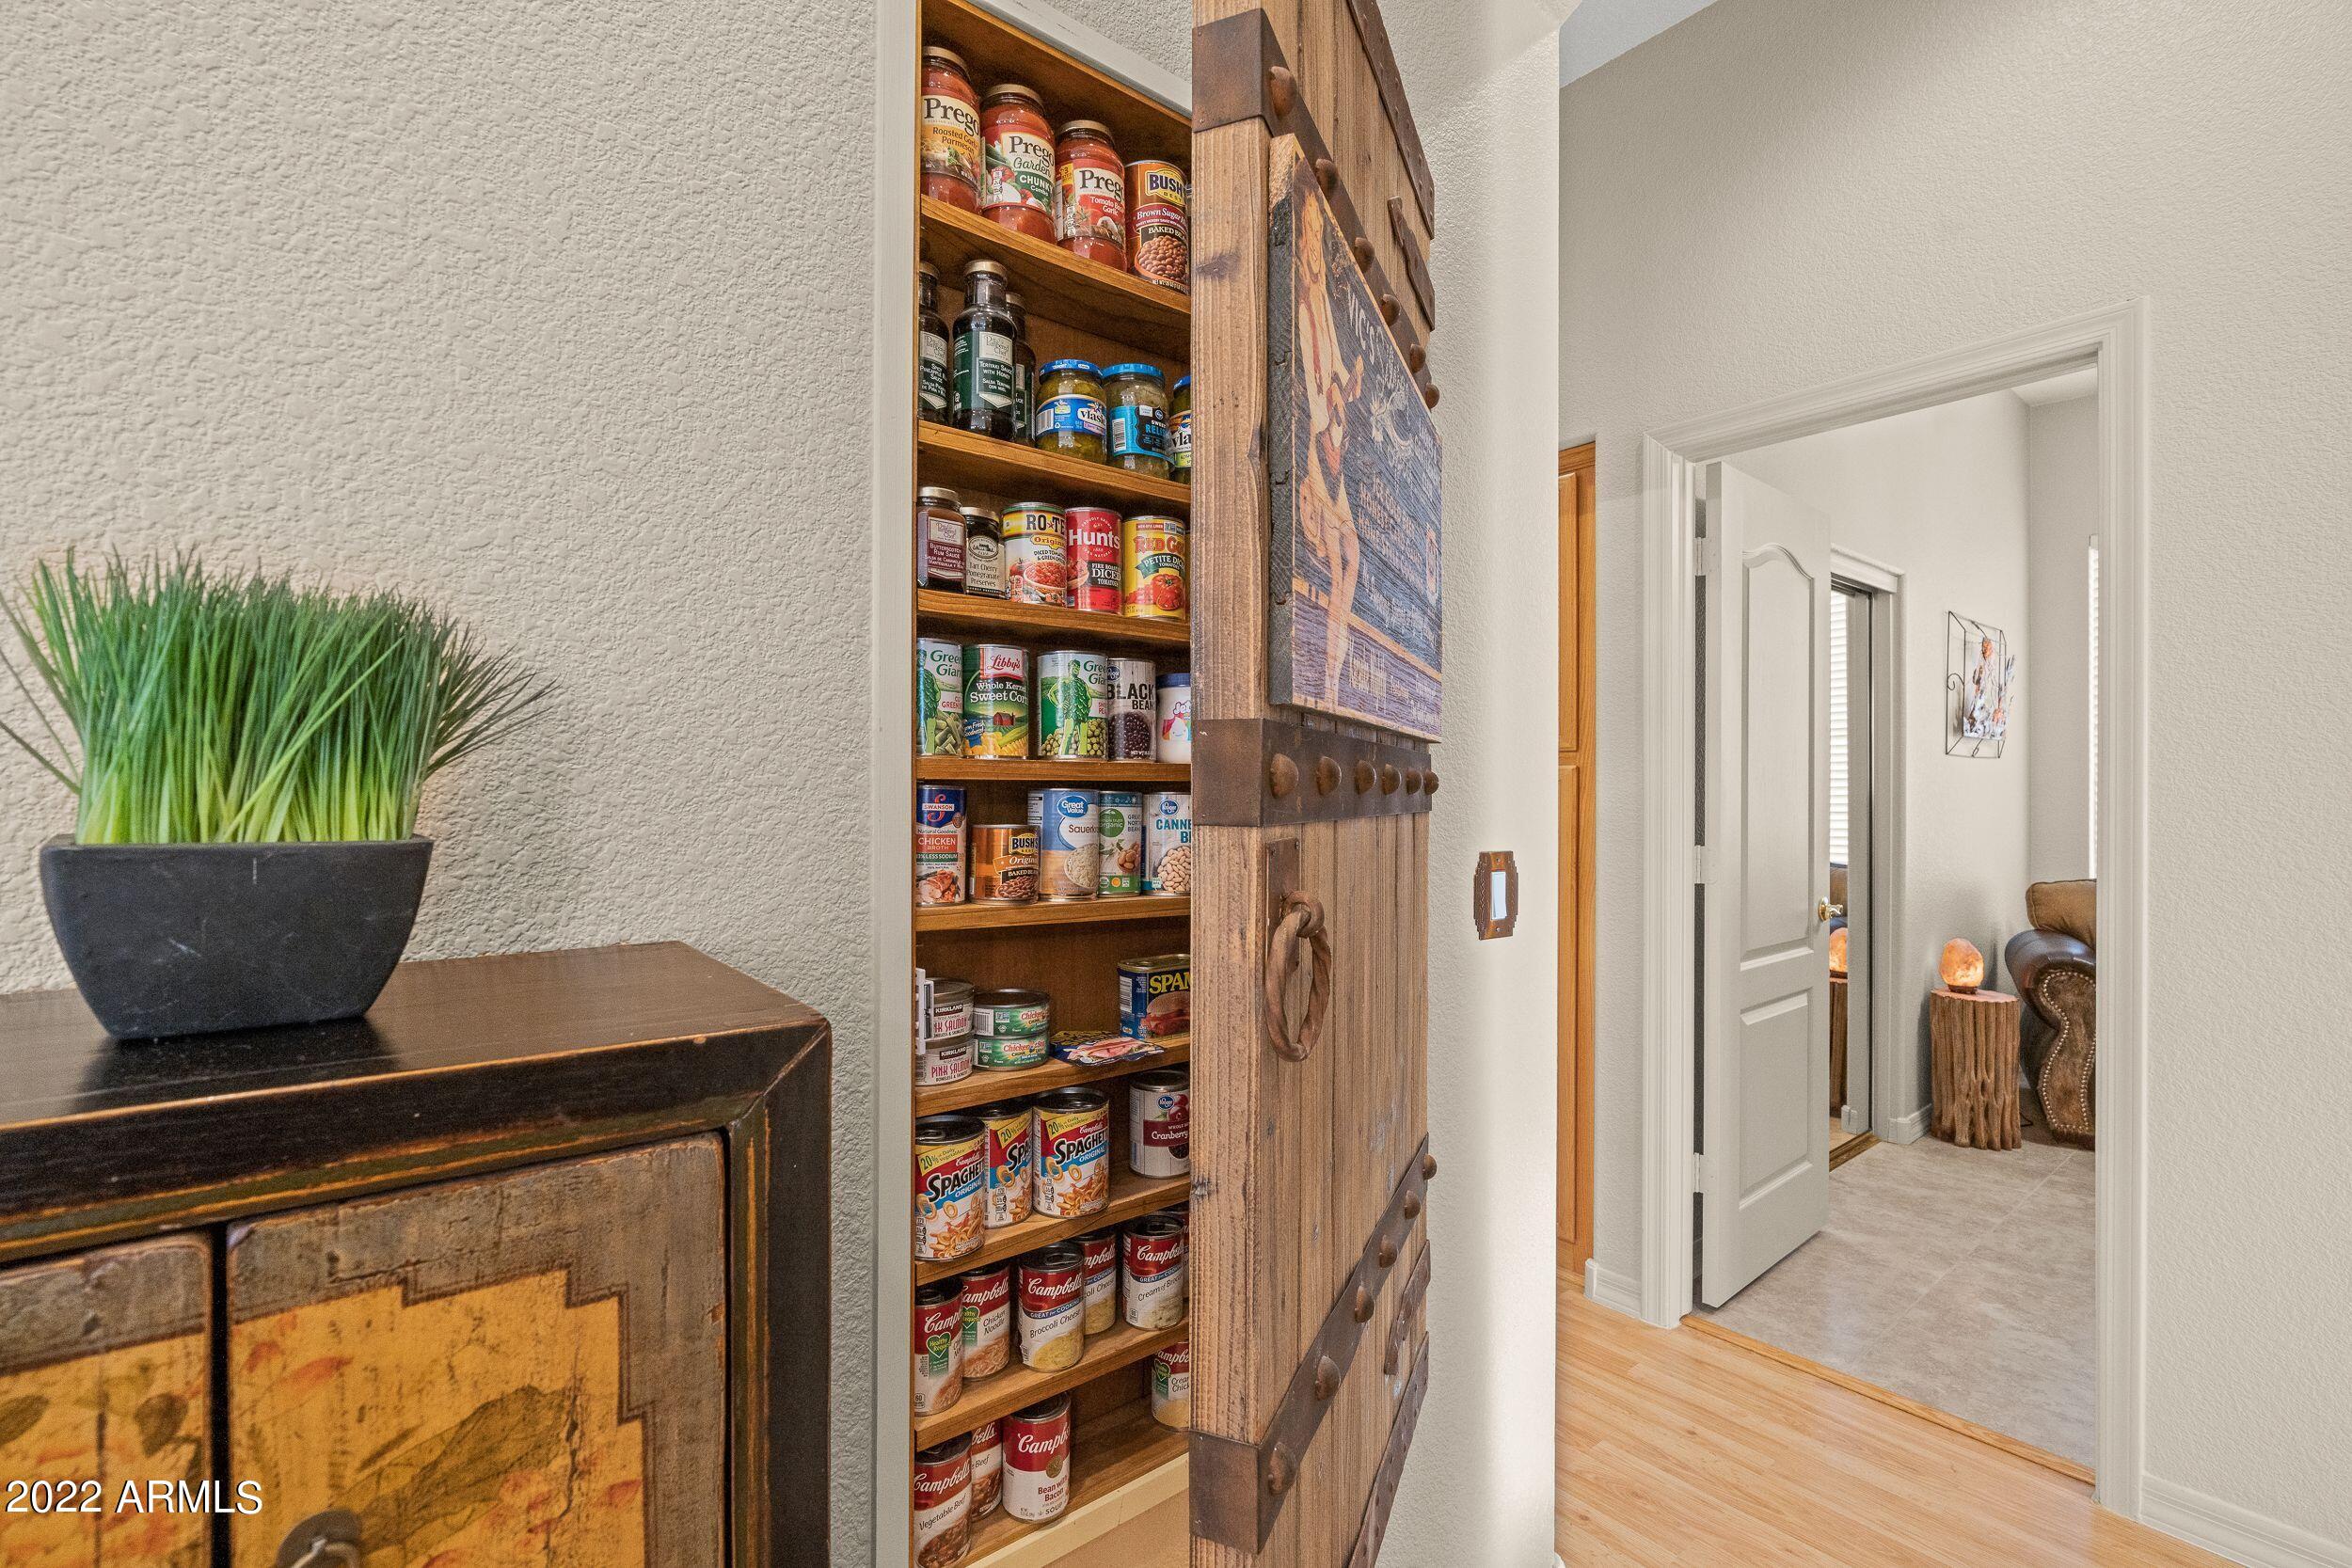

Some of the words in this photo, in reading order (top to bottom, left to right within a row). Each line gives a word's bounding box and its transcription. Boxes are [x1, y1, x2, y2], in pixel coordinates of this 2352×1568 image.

[933, 127, 963, 140] Roasted
[942, 136, 975, 154] Parmesan
[1079, 169, 1123, 203] Preg
[1090, 196, 1114, 208] Tomato
[1137, 210, 1161, 220] Brown
[1162, 208, 1181, 221] Sugar
[1149, 226, 1174, 234] BAKED
[980, 563, 997, 572] Cherry
[1144, 555, 1172, 567] PETITE
[1091, 568, 1120, 581] DICED
[971, 578, 996, 587] Preserves
[930, 650, 960, 663] Gree
[986, 655, 1021, 671] Libby's
[977, 681, 1004, 691] Whole
[1107, 683, 1154, 700] BLACK
[970, 691, 1008, 704] Sweet
[1061, 800, 1084, 809] Great
[918, 837, 956, 846] CHICKEN
[935, 1005, 963, 1014] KIRKLAND
[946, 1017, 967, 1032] SALMON
[941, 1046, 966, 1056] KIRKLAND
[931, 1065, 948, 1078] PINK
[950, 1058, 970, 1074] SALMON
[1096, 1278, 1115, 1291] Cheese
[1137, 1286, 1160, 1302] Cream
[1161, 1283, 1167, 1291] of
[1057, 1299, 1081, 1314] COOKING
[983, 1309, 1006, 1328] Chicken
[1029, 1319, 1058, 1338] Broccoli
[1059, 1308, 1081, 1324] Cheese
[984, 1318, 1005, 1335] Noodle
[976, 1454, 990, 1468] Beef
[1038, 1484, 1056, 1495] Bean
[1044, 1488, 1064, 1502] Bacon
[918, 1505, 953, 1530] Vegetable
[954, 1495, 966, 1511] Beef
[1045, 1501, 1063, 1515] SOUP
